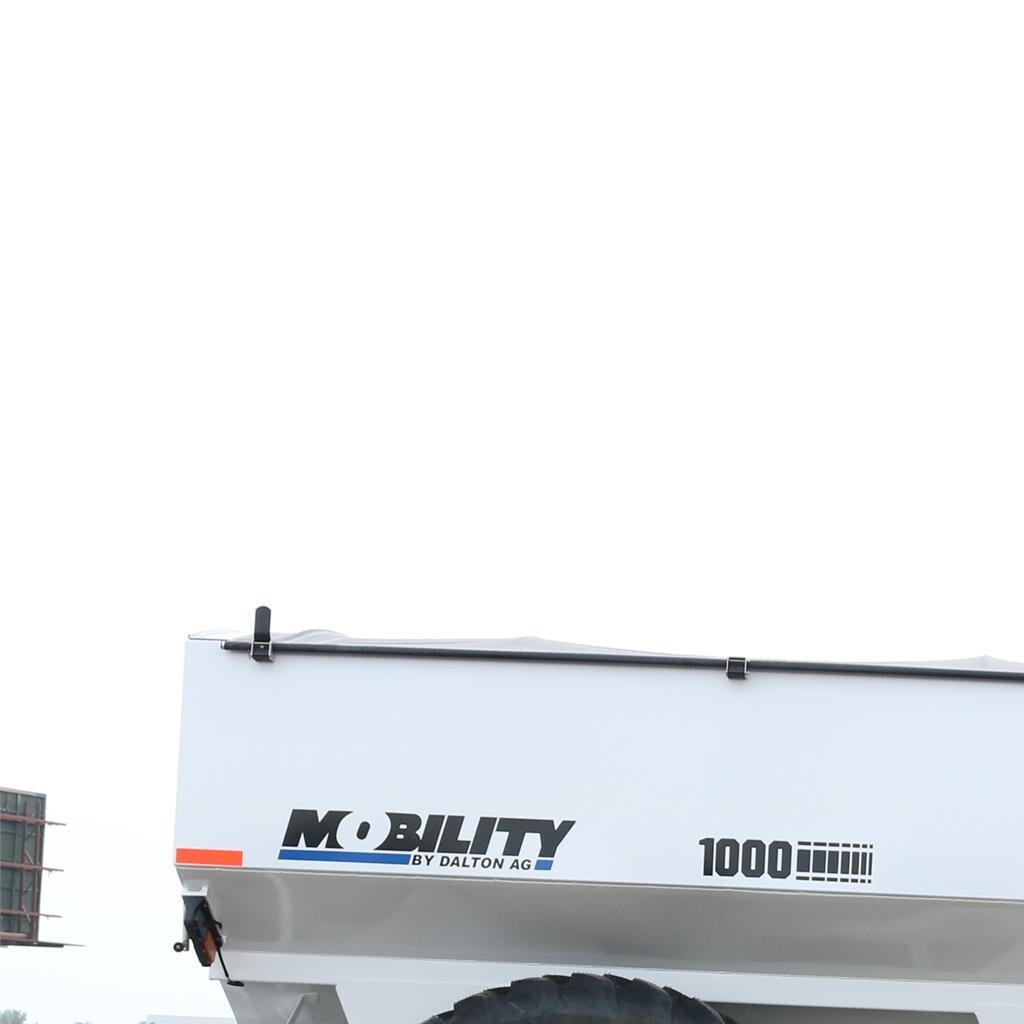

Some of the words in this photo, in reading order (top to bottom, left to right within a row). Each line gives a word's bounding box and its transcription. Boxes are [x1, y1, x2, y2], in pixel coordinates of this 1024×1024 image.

[281, 808, 577, 858] MOBILITY
[411, 854, 434, 867] BY
[439, 856, 505, 870] DALTON
[509, 858, 532, 871] AG
[698, 837, 793, 880] 1000
